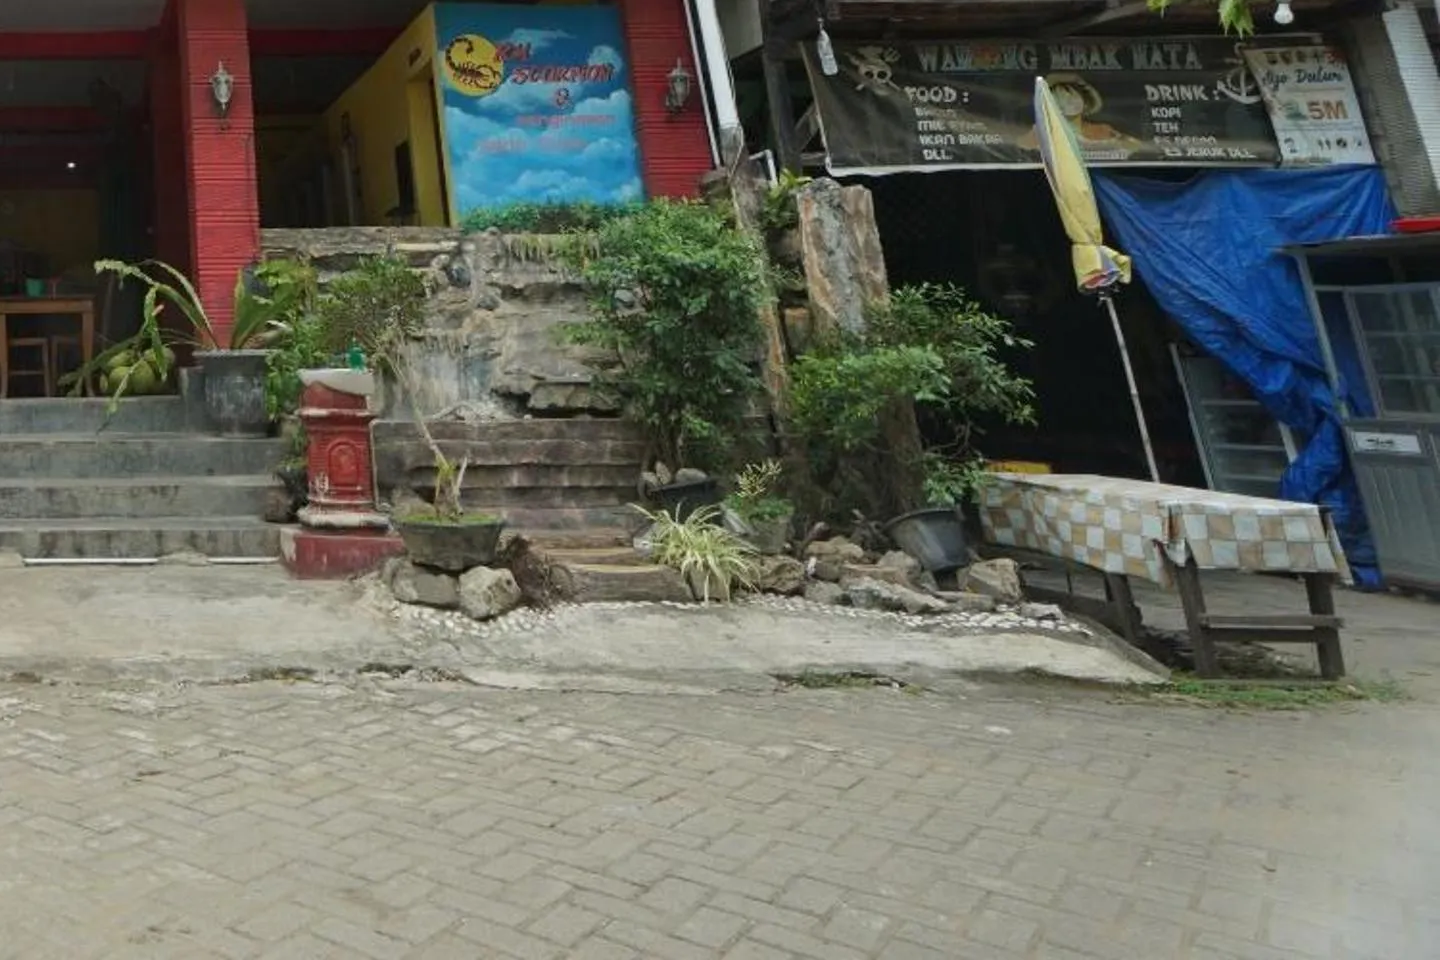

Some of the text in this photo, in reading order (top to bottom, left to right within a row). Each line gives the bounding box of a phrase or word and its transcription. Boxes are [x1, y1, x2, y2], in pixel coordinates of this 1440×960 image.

[918, 44, 1038, 71] WANG
[904, 86, 957, 102] FOOD
[1144, 84, 1209, 101] DRINK
[1152, 107, 1181, 118] KOPI
[1307, 100, 1349, 119] 5M
[1153, 123, 1179, 133] TEH
